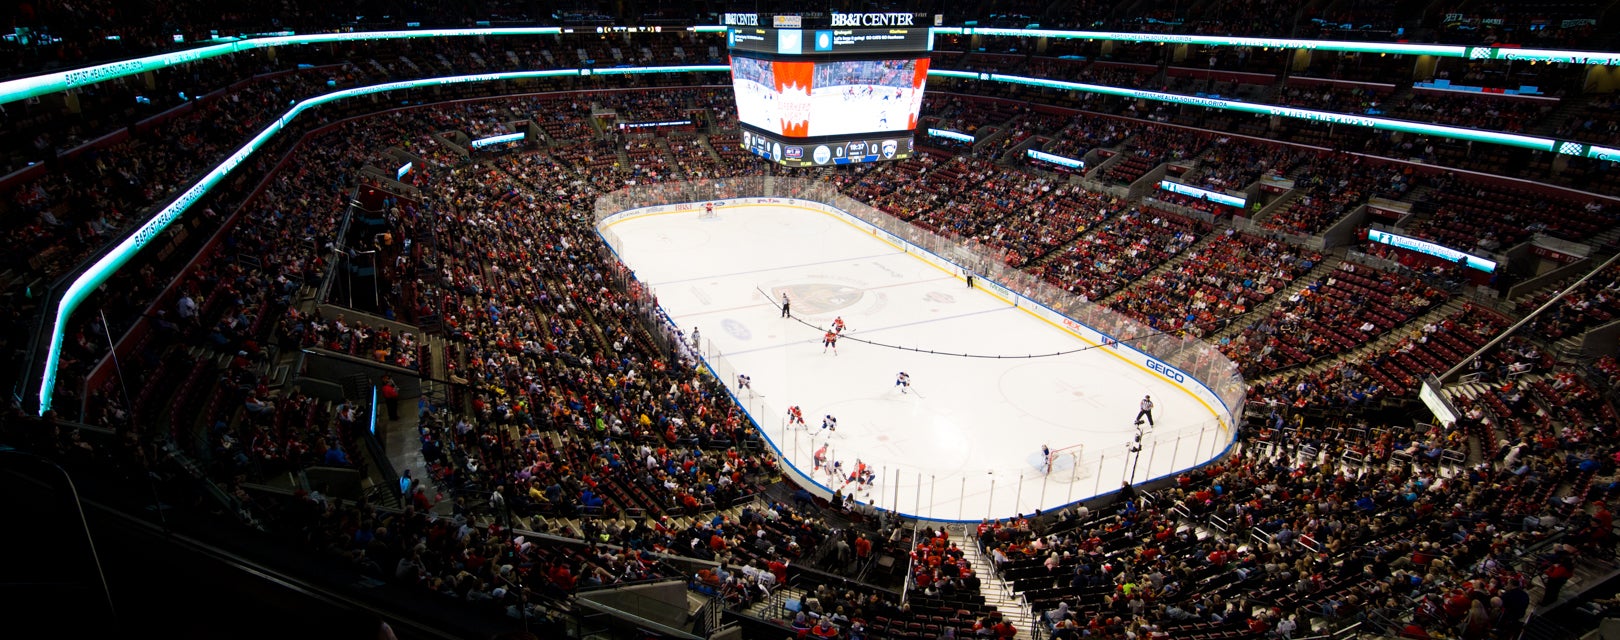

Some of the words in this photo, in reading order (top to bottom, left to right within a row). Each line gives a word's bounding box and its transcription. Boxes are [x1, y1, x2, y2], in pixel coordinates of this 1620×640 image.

[737, 14, 758, 26] CENTER
[831, 13, 862, 27] BB&T
[863, 13, 914, 26] CENTER
[65, 70, 88, 86] BAPTIST
[1201, 99, 1228, 107] FLORIDA
[1284, 110, 1312, 119] WHERE
[1315, 113, 1332, 121] THE
[1334, 116, 1359, 125] PROS
[836, 146, 843, 157] 0
[871, 143, 878, 154] 0
[134, 220, 157, 248] BAPTIST
[1146, 359, 1184, 384] GEICO
